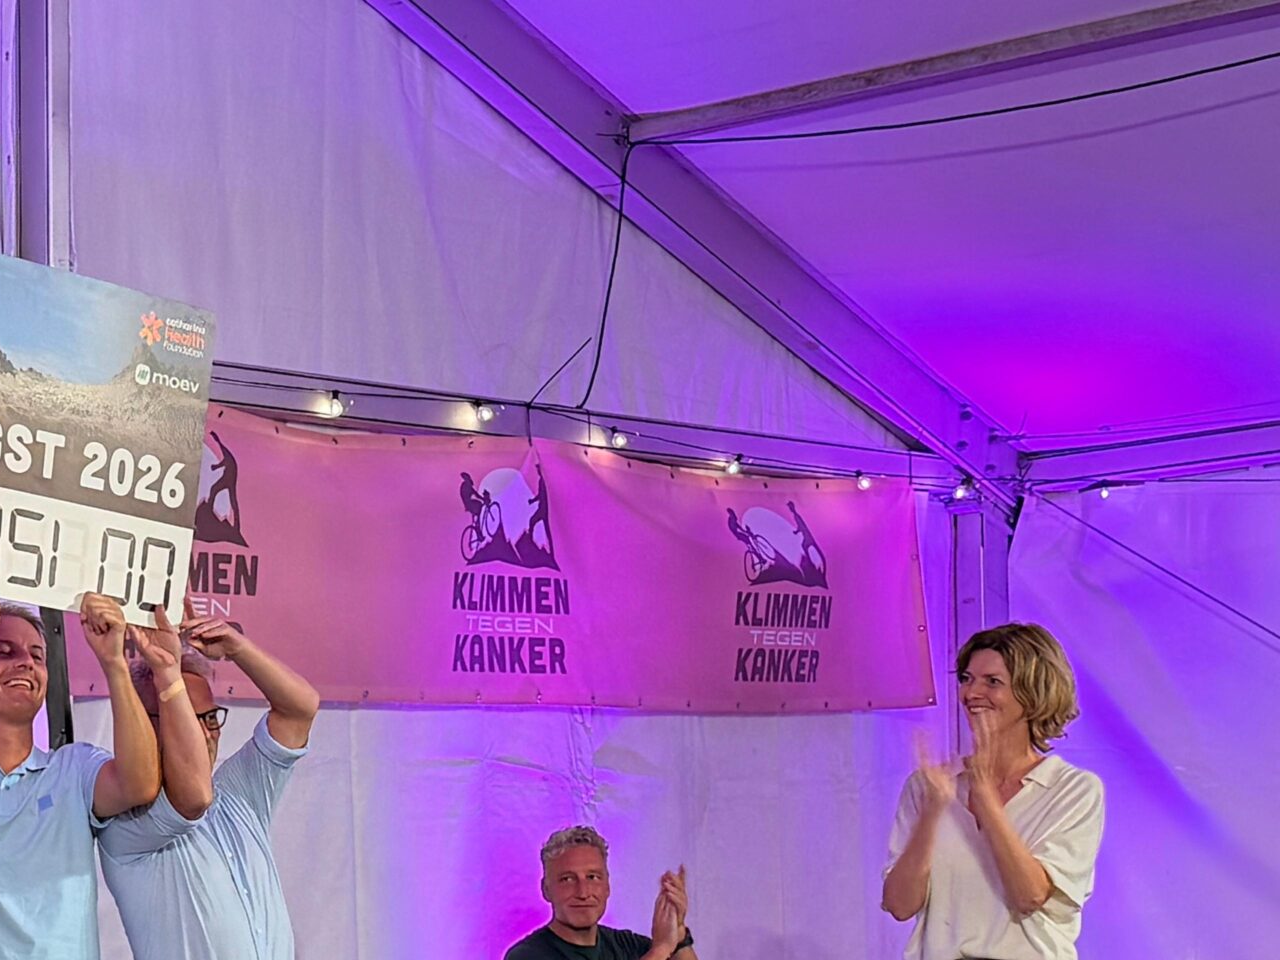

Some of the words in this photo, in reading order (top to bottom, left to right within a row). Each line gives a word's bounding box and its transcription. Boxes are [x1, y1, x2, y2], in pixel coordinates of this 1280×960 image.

[152, 371, 200, 394] moev
[80, 441, 185, 509] 2026
[97, 528, 176, 613] 00
[452, 571, 570, 615] KLIMMEN
[735, 591, 832, 629] KLIMMEN
[466, 614, 554, 634] TEGEN
[750, 630, 816, 646] TEGEN
[452, 634, 567, 674] KANKER
[734, 648, 820, 683] KANKER
